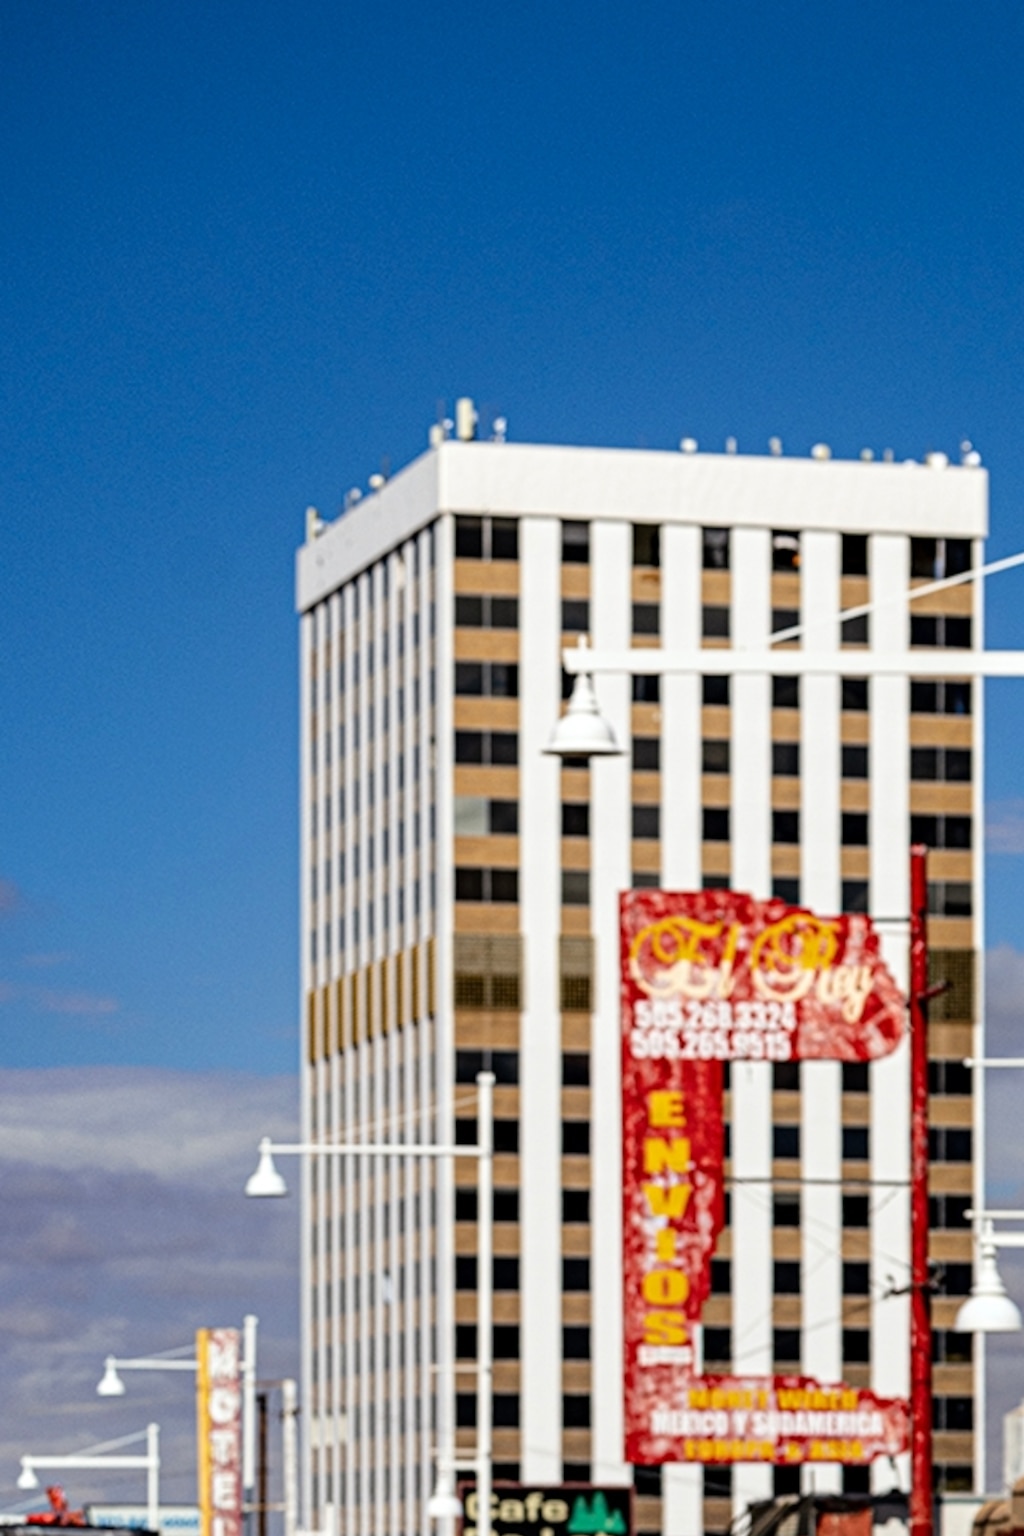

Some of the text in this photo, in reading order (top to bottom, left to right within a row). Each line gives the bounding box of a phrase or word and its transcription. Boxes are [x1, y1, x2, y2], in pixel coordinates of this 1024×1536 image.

[630, 914, 875, 1022] El Rey
[641, 1089, 693, 1345] ENVIOS
[732, 1411, 749, 1435] Y
[465, 1491, 569, 1523] Cafe
